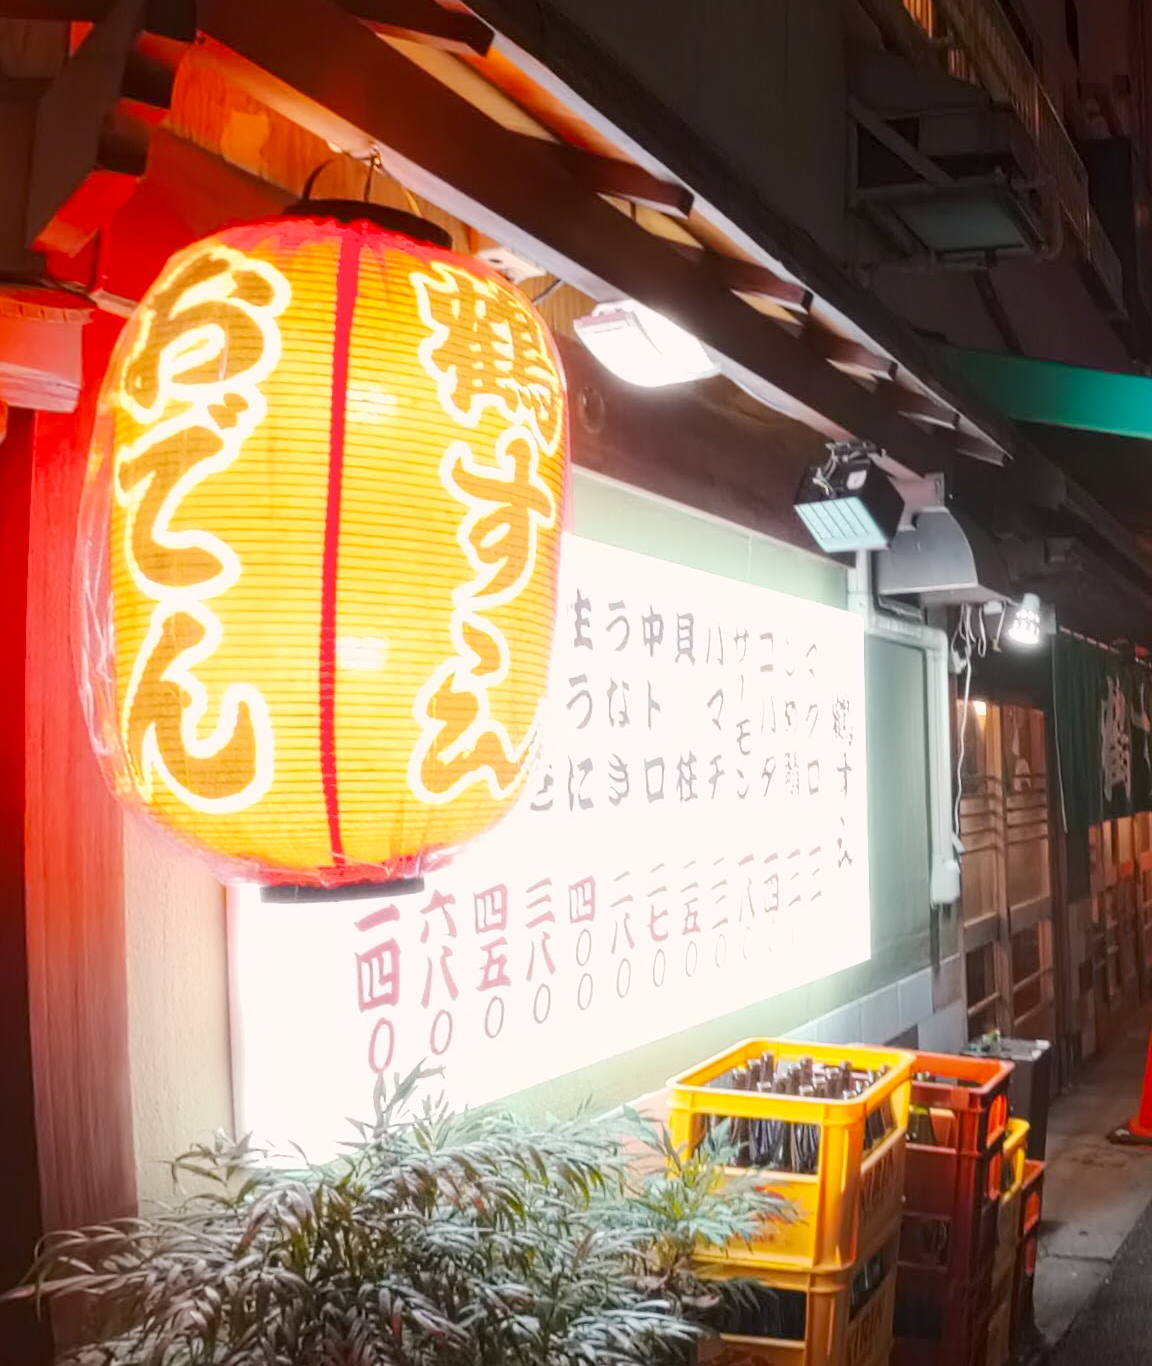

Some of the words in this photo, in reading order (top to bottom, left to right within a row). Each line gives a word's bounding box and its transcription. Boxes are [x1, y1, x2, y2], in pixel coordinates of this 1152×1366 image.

[114, 245, 291, 815] おでん
[733, 626, 752, 799] サーモン
